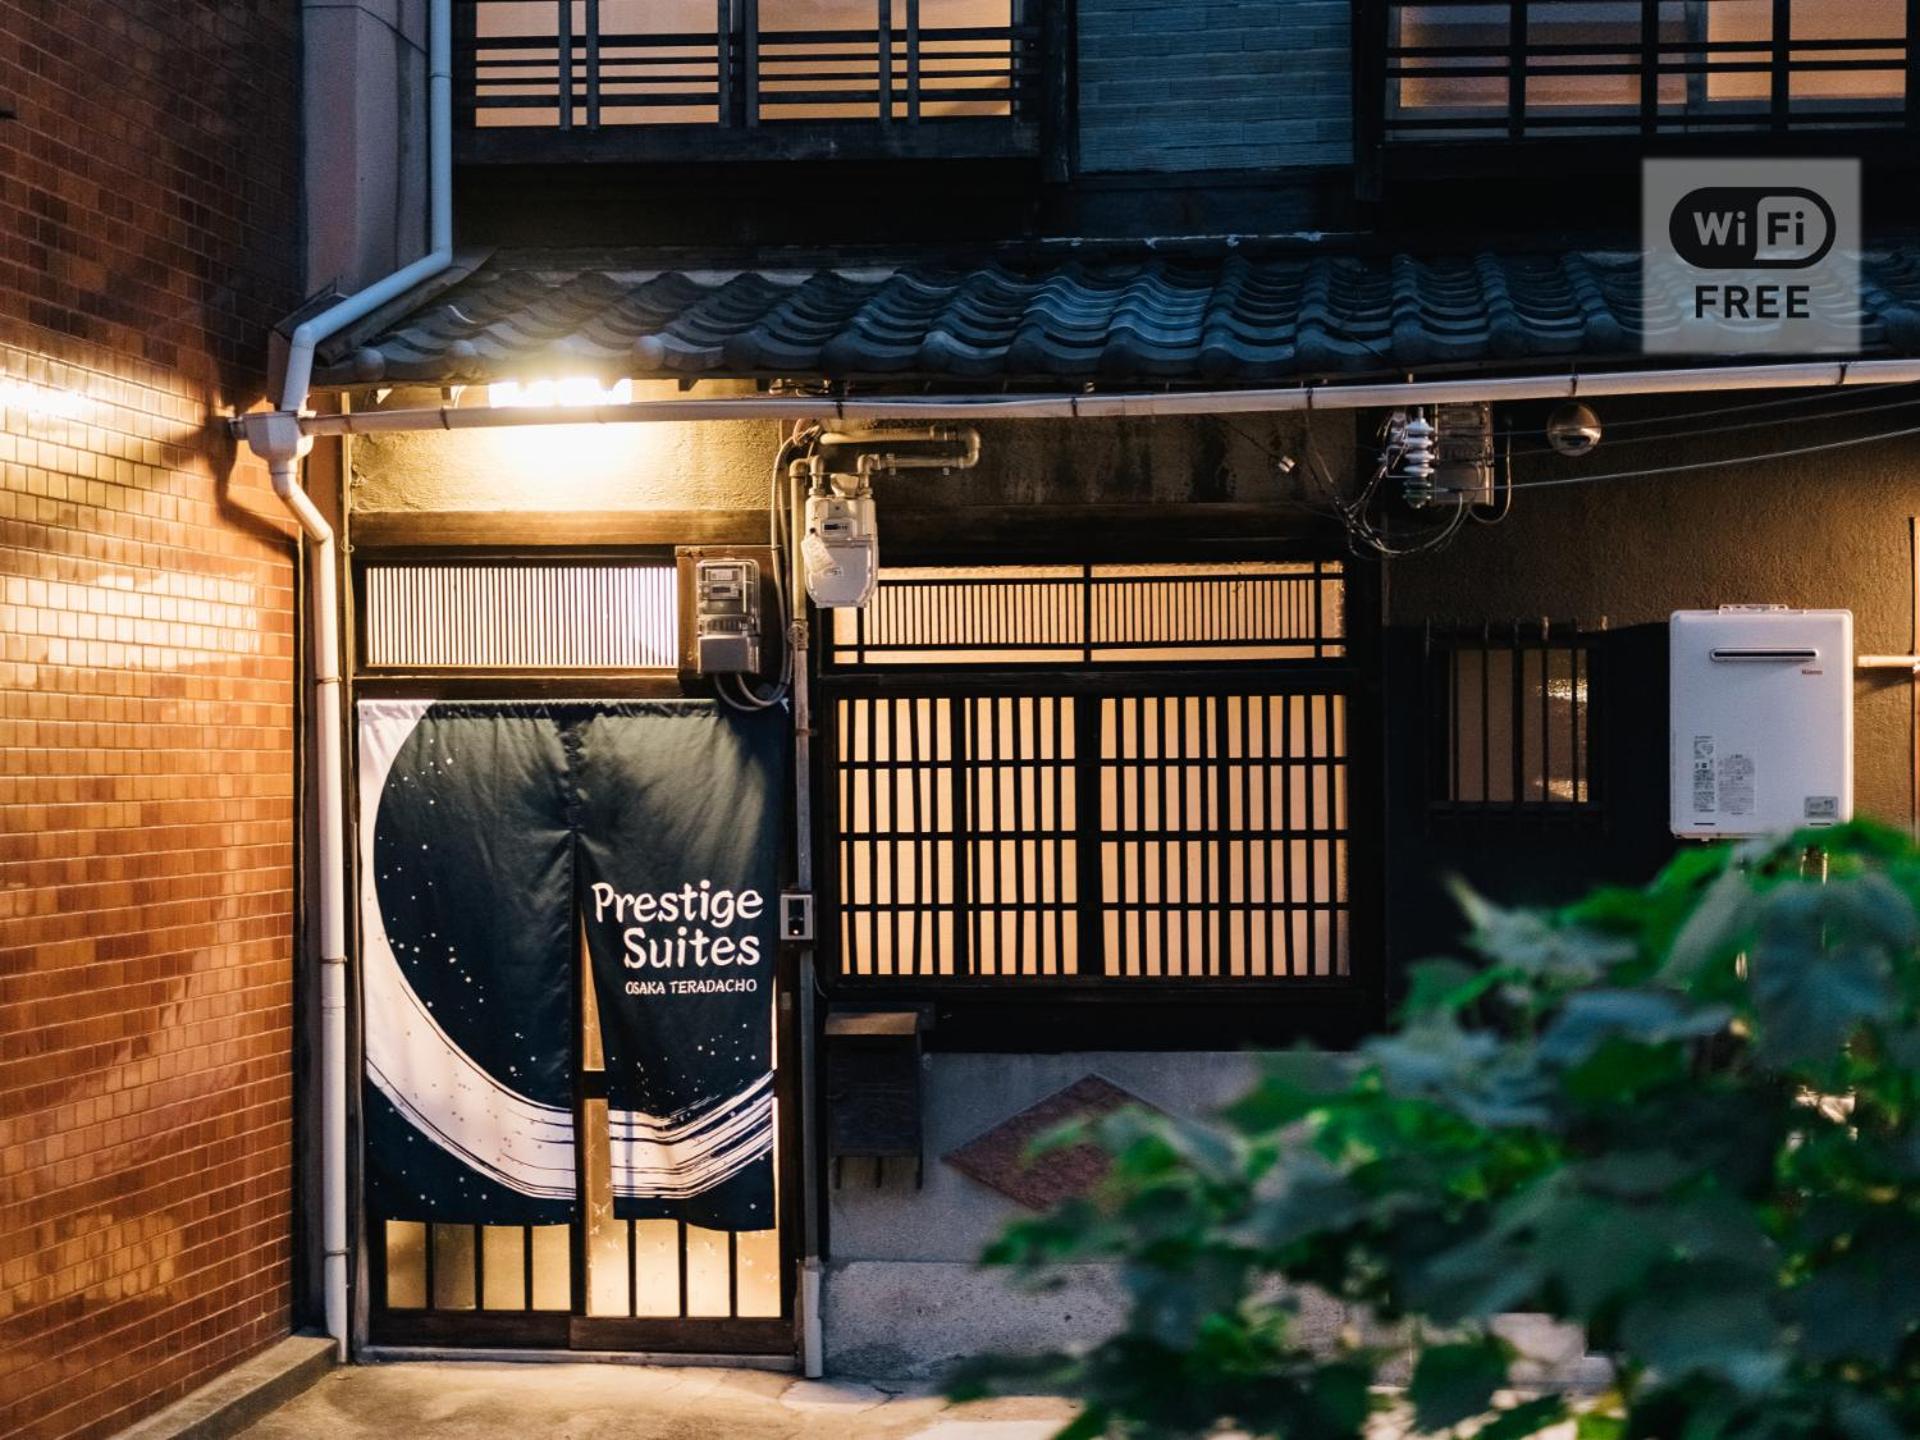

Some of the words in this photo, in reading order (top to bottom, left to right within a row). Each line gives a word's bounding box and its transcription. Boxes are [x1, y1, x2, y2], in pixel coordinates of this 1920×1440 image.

[591, 879, 764, 928] Prestige
[623, 926, 761, 969] Suites
[625, 981, 665, 995] OSAKA
[669, 979, 758, 994] TERADACHO
